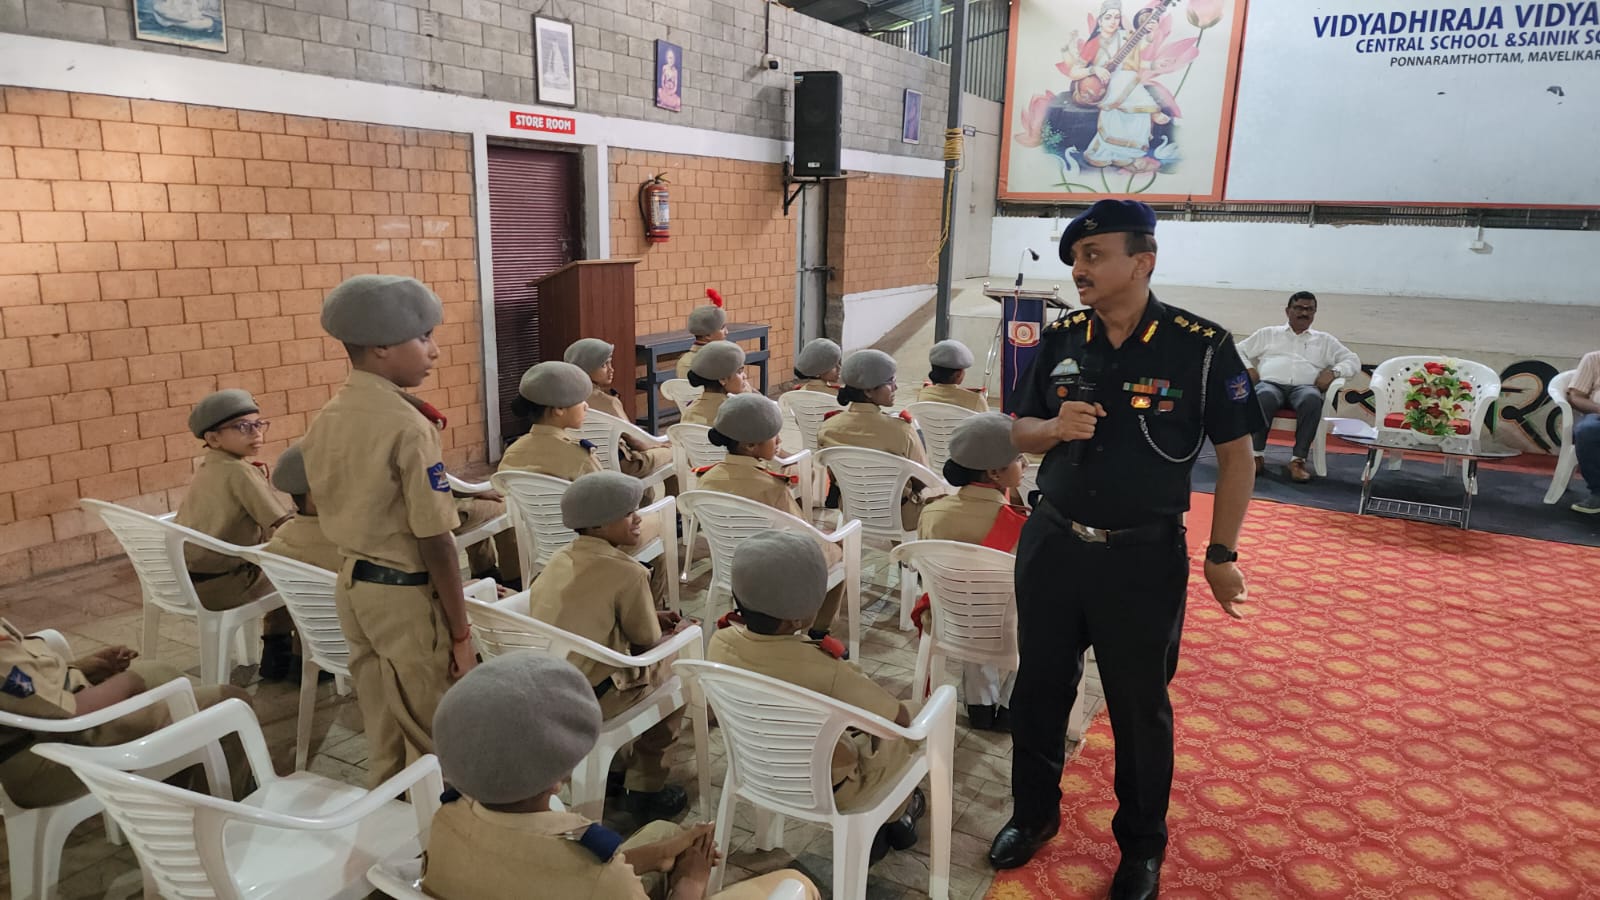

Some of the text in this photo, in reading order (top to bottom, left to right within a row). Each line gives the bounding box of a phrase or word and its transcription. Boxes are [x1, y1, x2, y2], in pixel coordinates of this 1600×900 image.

[1313, 1, 1599, 38] VIDYADHIRAJA VIDYA
[1356, 37, 1425, 53] CENTRAL
[1430, 33, 1499, 50] SCHOOL
[1390, 53, 1524, 67] PONNARAMTHOTTAM,
[515, 114, 572, 131] STORE ROOM
